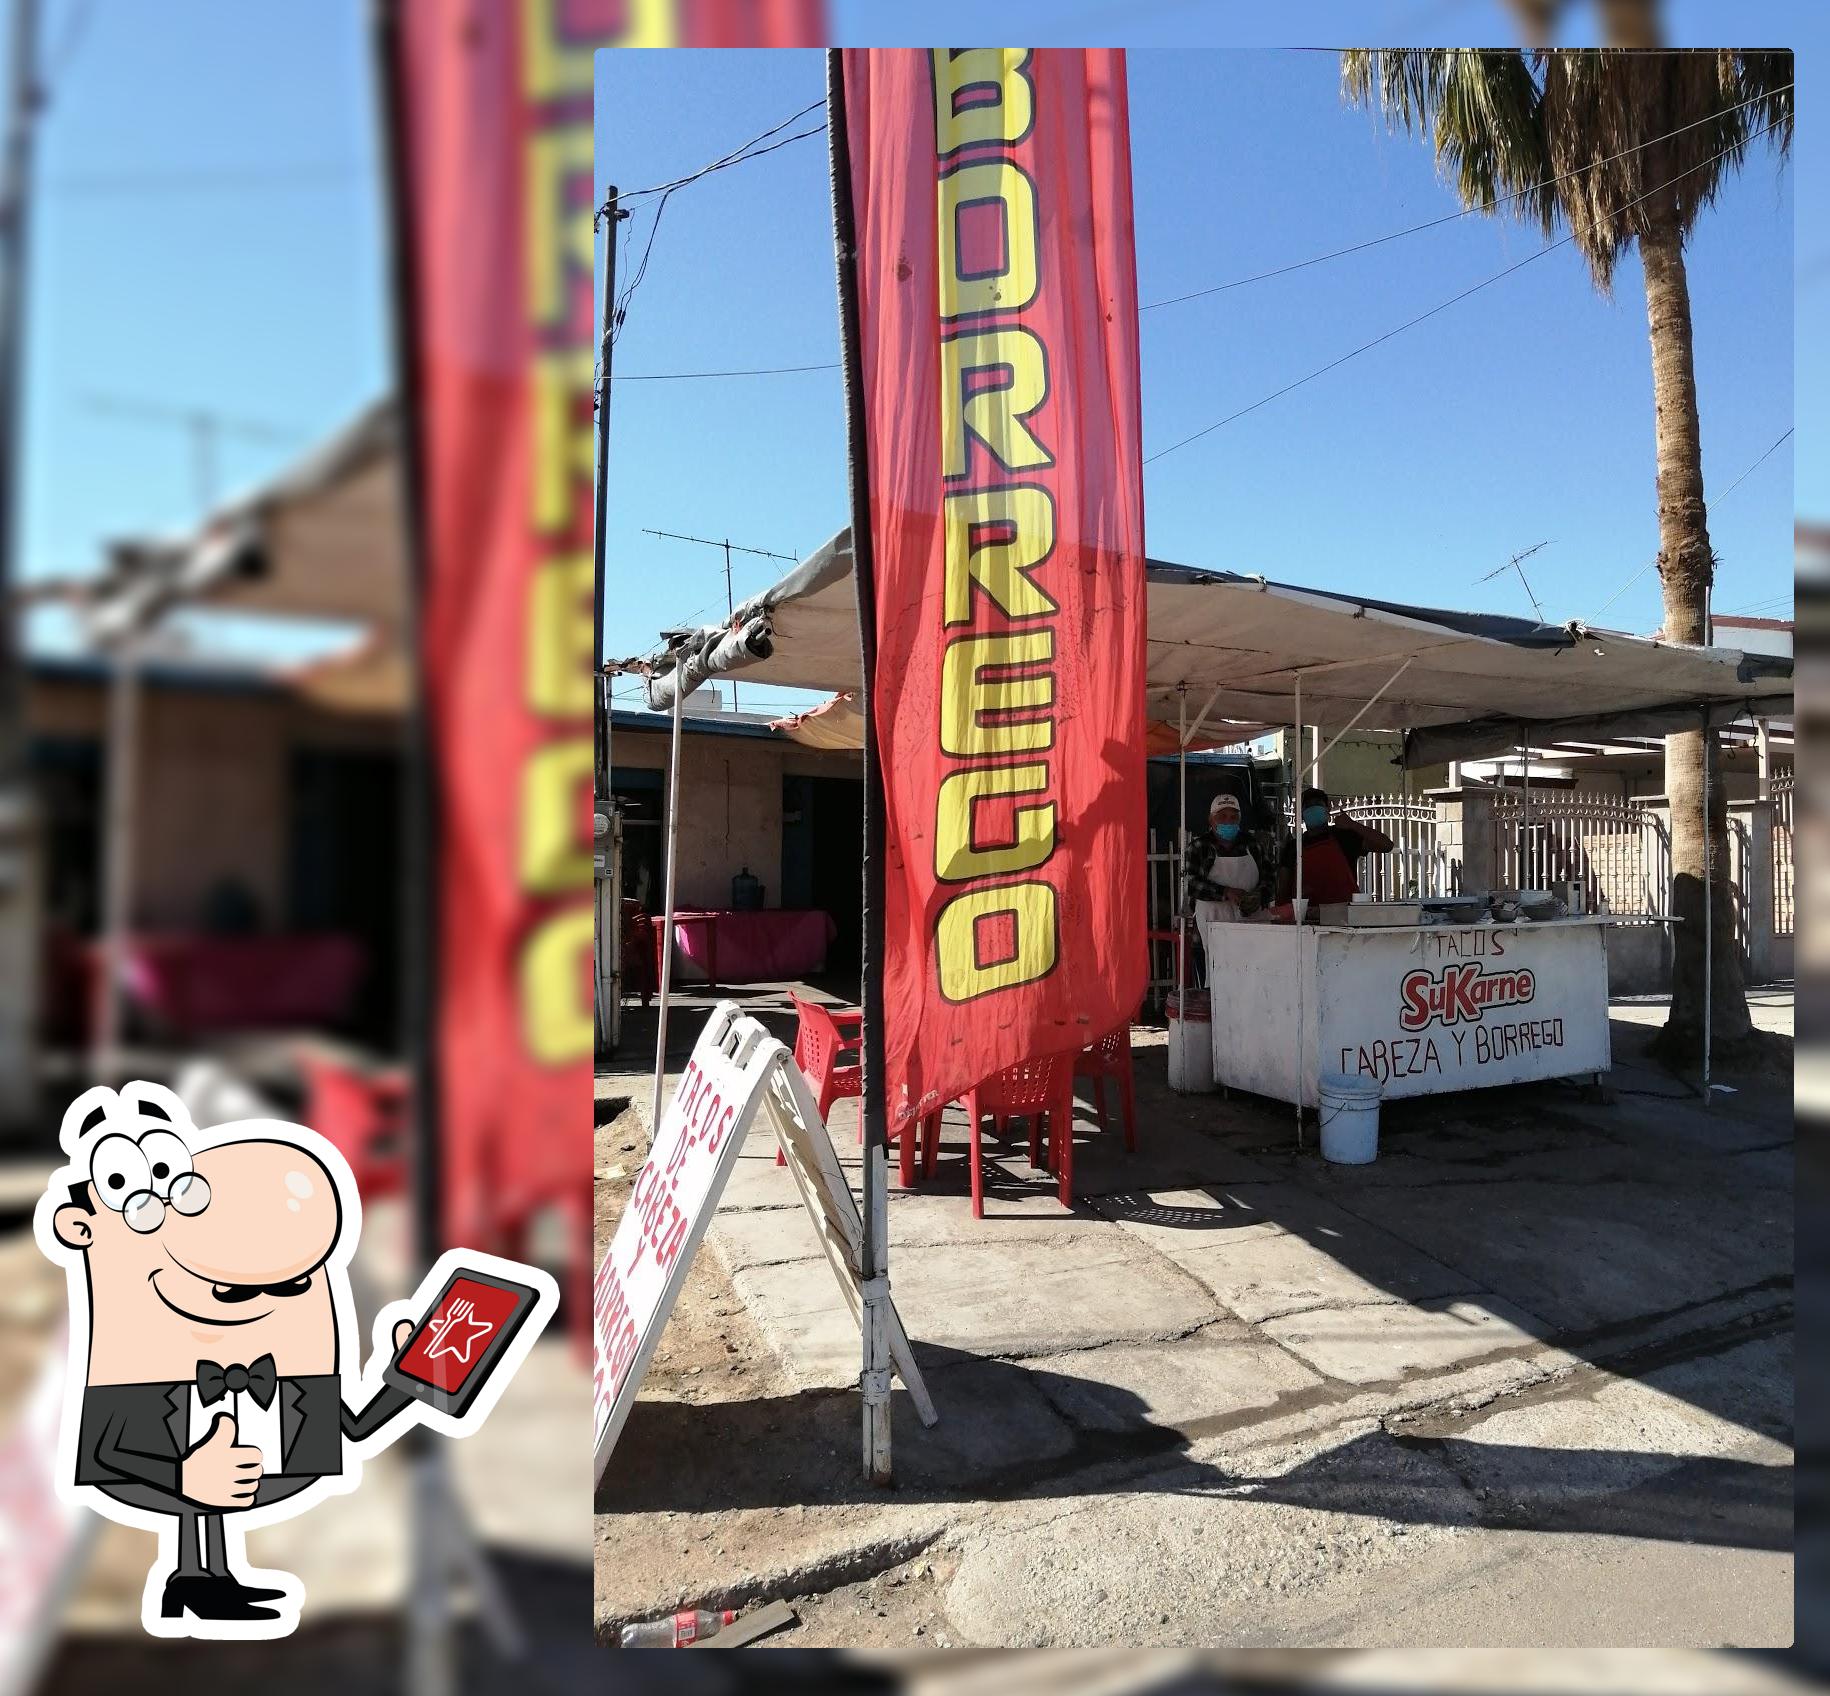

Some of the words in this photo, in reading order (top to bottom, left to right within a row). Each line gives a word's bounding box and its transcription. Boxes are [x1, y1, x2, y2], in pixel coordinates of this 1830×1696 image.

[929, 48, 1061, 1004] BORREGO
[1436, 929, 1505, 958] TACOS
[1401, 962, 1535, 1031] SuKarne
[1451, 1030, 1466, 1067] Y
[1475, 1018, 1564, 1065] BORREGO
[678, 1059, 734, 1154] TACOS
[666, 1125, 697, 1191] DE
[634, 1160, 689, 1279] CABEZA
[627, 1236, 646, 1279] Y
